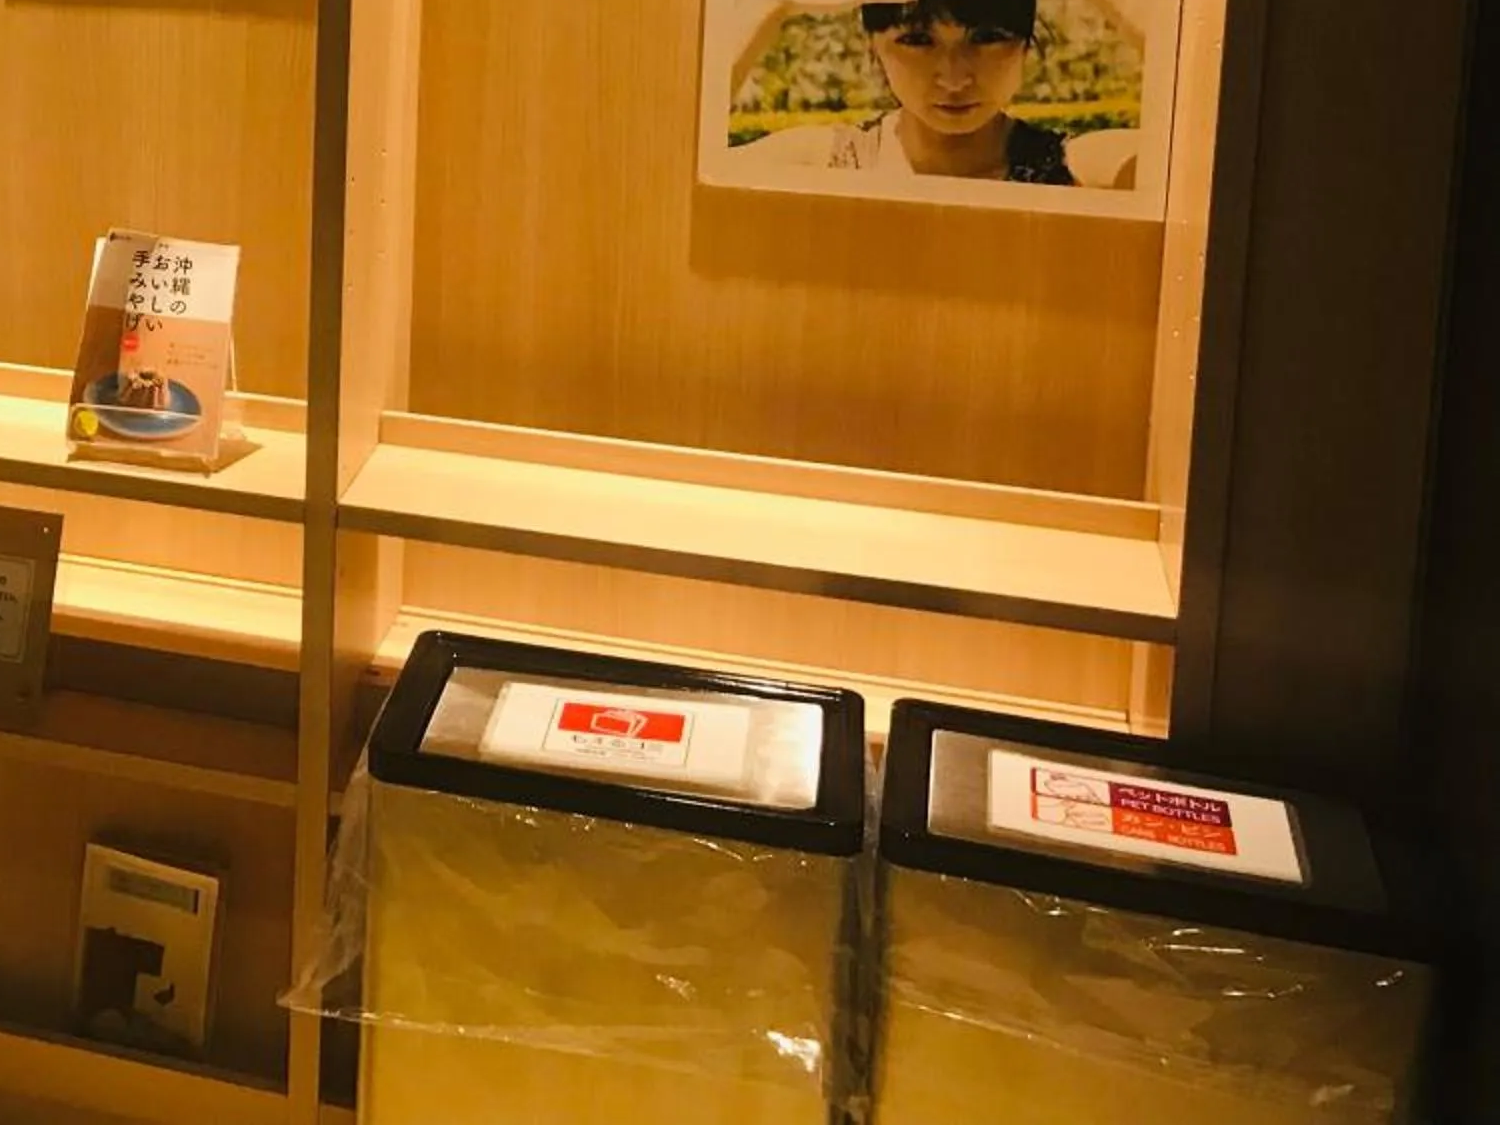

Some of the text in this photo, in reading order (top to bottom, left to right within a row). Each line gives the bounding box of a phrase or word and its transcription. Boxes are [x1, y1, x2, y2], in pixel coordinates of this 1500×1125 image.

[126, 250, 150, 332] 手みやげ
[145, 255, 171, 332] おいしい
[170, 256, 193, 315] 沖縄の
[1118, 787, 1222, 812] ペットボトル
[1120, 798, 1222, 824] PET BOTTLES
